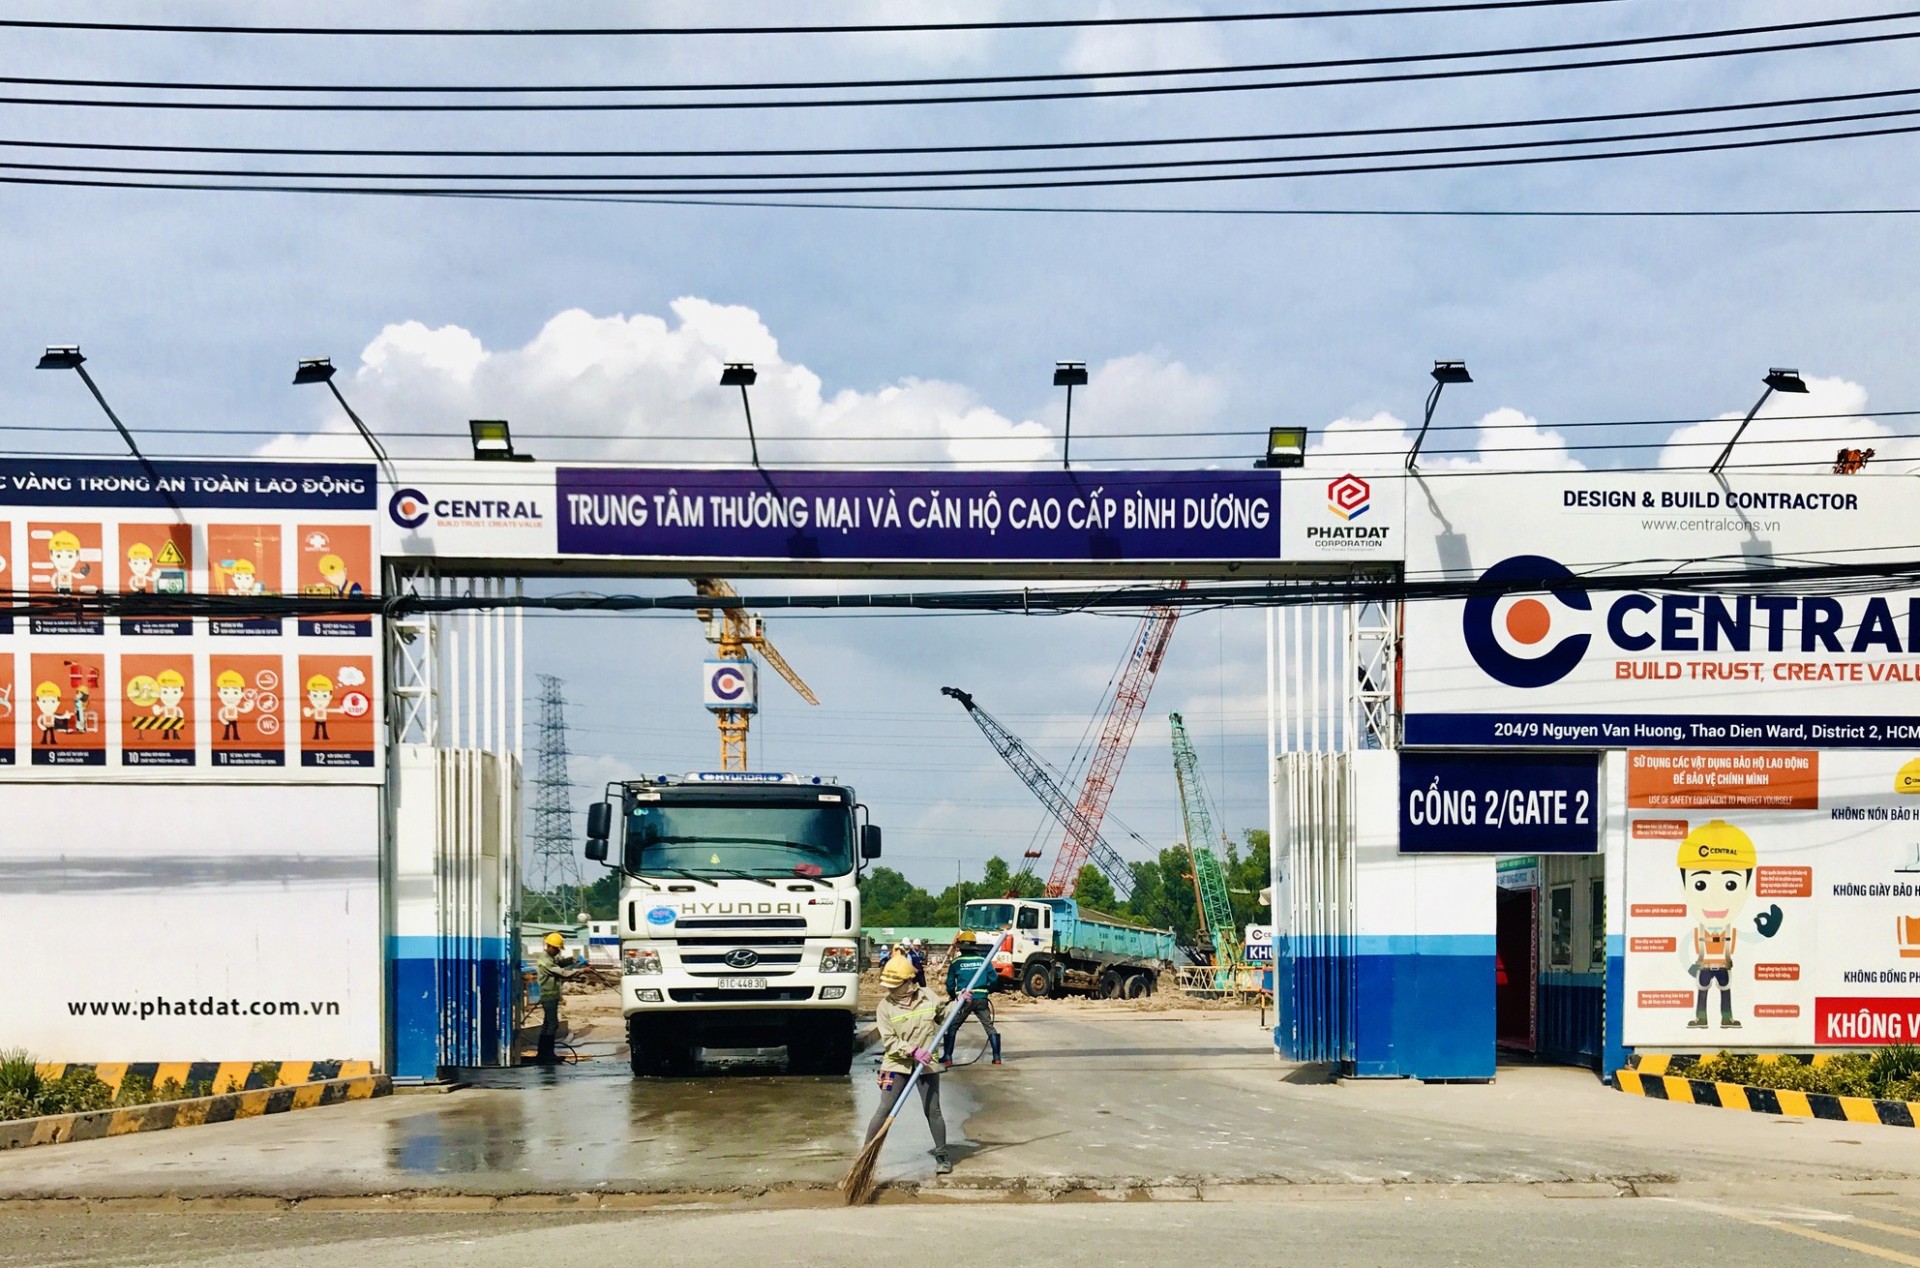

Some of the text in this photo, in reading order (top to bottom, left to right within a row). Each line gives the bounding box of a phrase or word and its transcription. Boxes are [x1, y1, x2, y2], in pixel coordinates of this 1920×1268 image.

[12, 471, 72, 491] VÀNG
[78, 476, 150, 492] TRONG
[155, 476, 185, 492] AN
[190, 474, 249, 493] TOÀN
[255, 477, 297, 493] LAO
[302, 475, 365, 497] ĐỘNG
[1563, 491, 1857, 510] DESIGN & BUILD CONTRACTOR
[434, 500, 543, 518] CENTRAL
[567, 486, 1270, 535] TRUNG TÂM THƯƠNG MẠI VÀ CĂN HỘ CAO CẤP BÌNH DƯƠNG
[488, 520, 517, 528] CREATE
[518, 520, 543, 528] VALUE
[1642, 519, 1780, 532] www.centralcons.vn
[1307, 527, 1389, 538] PHATDAT
[35, 620, 42, 633] 3
[134, 623, 141, 634] 4
[213, 622, 220, 634] 5
[314, 623, 321, 635] 6
[1615, 662, 1682, 679] BUILD
[1687, 662, 1764, 682] TRUST,
[1773, 663, 1862, 681] CREATE
[262, 720, 274, 730] WC
[1494, 723, 1538, 738] 204/9
[1542, 724, 1598, 740] Nguyen
[1602, 724, 1630, 737] Van
[1634, 724, 1686, 740] Huong,
[1690, 724, 1726, 738] Thao
[1730, 724, 1762, 738] Dien
[1766, 724, 1807, 740] Ward,
[1812, 724, 1865, 738] District
[1869, 726, 1882, 740] 2,
[49, 751, 56, 763] 9
[128, 752, 139, 763] 10
[219, 752, 228, 764] 11
[315, 753, 326, 764] 12
[1647, 757, 1671, 770] DỤNG
[1672, 756, 1689, 768] CÁC
[1691, 756, 1706, 770] VẬT
[1708, 757, 1731, 770] DỤNG
[1733, 755, 1751, 769] BẢO
[1752, 756, 1764, 771] HỘ
[1766, 758, 1783, 769] LAO
[1785, 756, 1809, 771] ĐỘNG
[715, 773, 766, 781] HYUNDAI
[1687, 772, 1704, 785] BẢO
[1705, 772, 1716, 786] VỆ
[1718, 772, 1744, 785] CHÍNH
[1746, 773, 1769, 785] MÌNH
[1409, 776, 1589, 828] CỔNG 2/GATE 2
[1648, 795, 1660, 804] USE
[1670, 795, 1692, 804] SAFETY
[1693, 795, 1727, 805] EQUIPMENT
[1728, 795, 1736, 805] TO
[1737, 795, 1762, 805] PROTECT
[1764, 796, 1793, 805] YOURSELF
[1831, 806, 1865, 820] KHÔNG
[1868, 806, 1888, 820] NÓN
[1891, 806, 1911, 820] BẢO
[1833, 882, 1867, 896] KHÔNG
[1869, 882, 1891, 896] GIÀY
[1893, 882, 1913, 896] BẢO
[682, 903, 800, 914] HYUNDAI
[1844, 969, 1877, 983] KHÔNG
[68, 996, 340, 1020] www.phatdat.com.vn
[1827, 1008, 1902, 1038] KHÔNG
